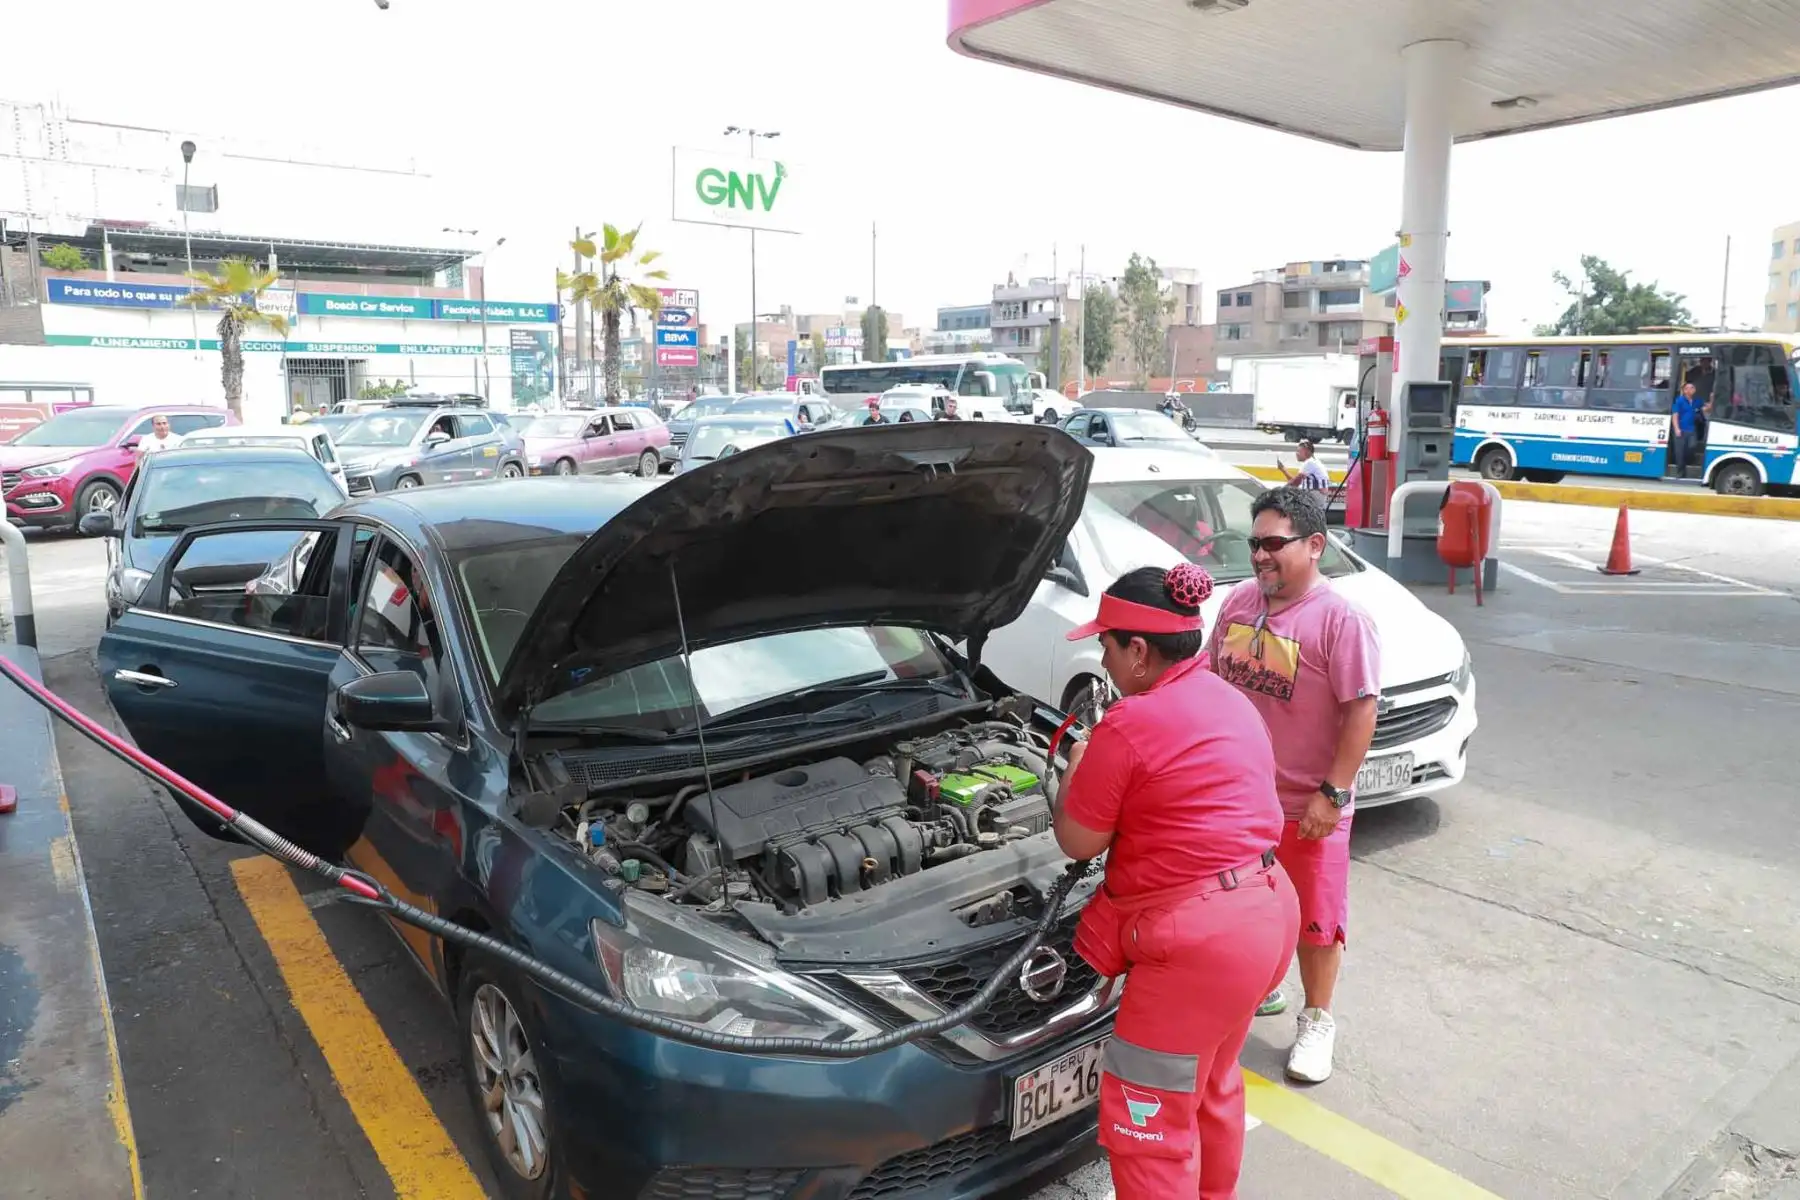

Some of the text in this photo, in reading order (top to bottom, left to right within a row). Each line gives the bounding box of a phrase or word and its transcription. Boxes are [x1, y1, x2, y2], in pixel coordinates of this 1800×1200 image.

[696, 168, 782, 211] GNV
[64, 285, 91, 296] Para
[94, 288, 120, 298] todo
[122, 289, 133, 299] lo
[136, 291, 156, 301] que
[159, 293, 172, 301] su
[326, 300, 415, 313] Bosch Car Service
[91, 337, 188, 349] ALINEAMIENTO
[664, 333, 689, 342] BBVA
[307, 342, 377, 353] SUSPENSION
[1051, 1050, 1086, 1077] PERU
[1019, 1058, 1099, 1130] BCL-16
[1113, 1123, 1164, 1142] Petroperú
